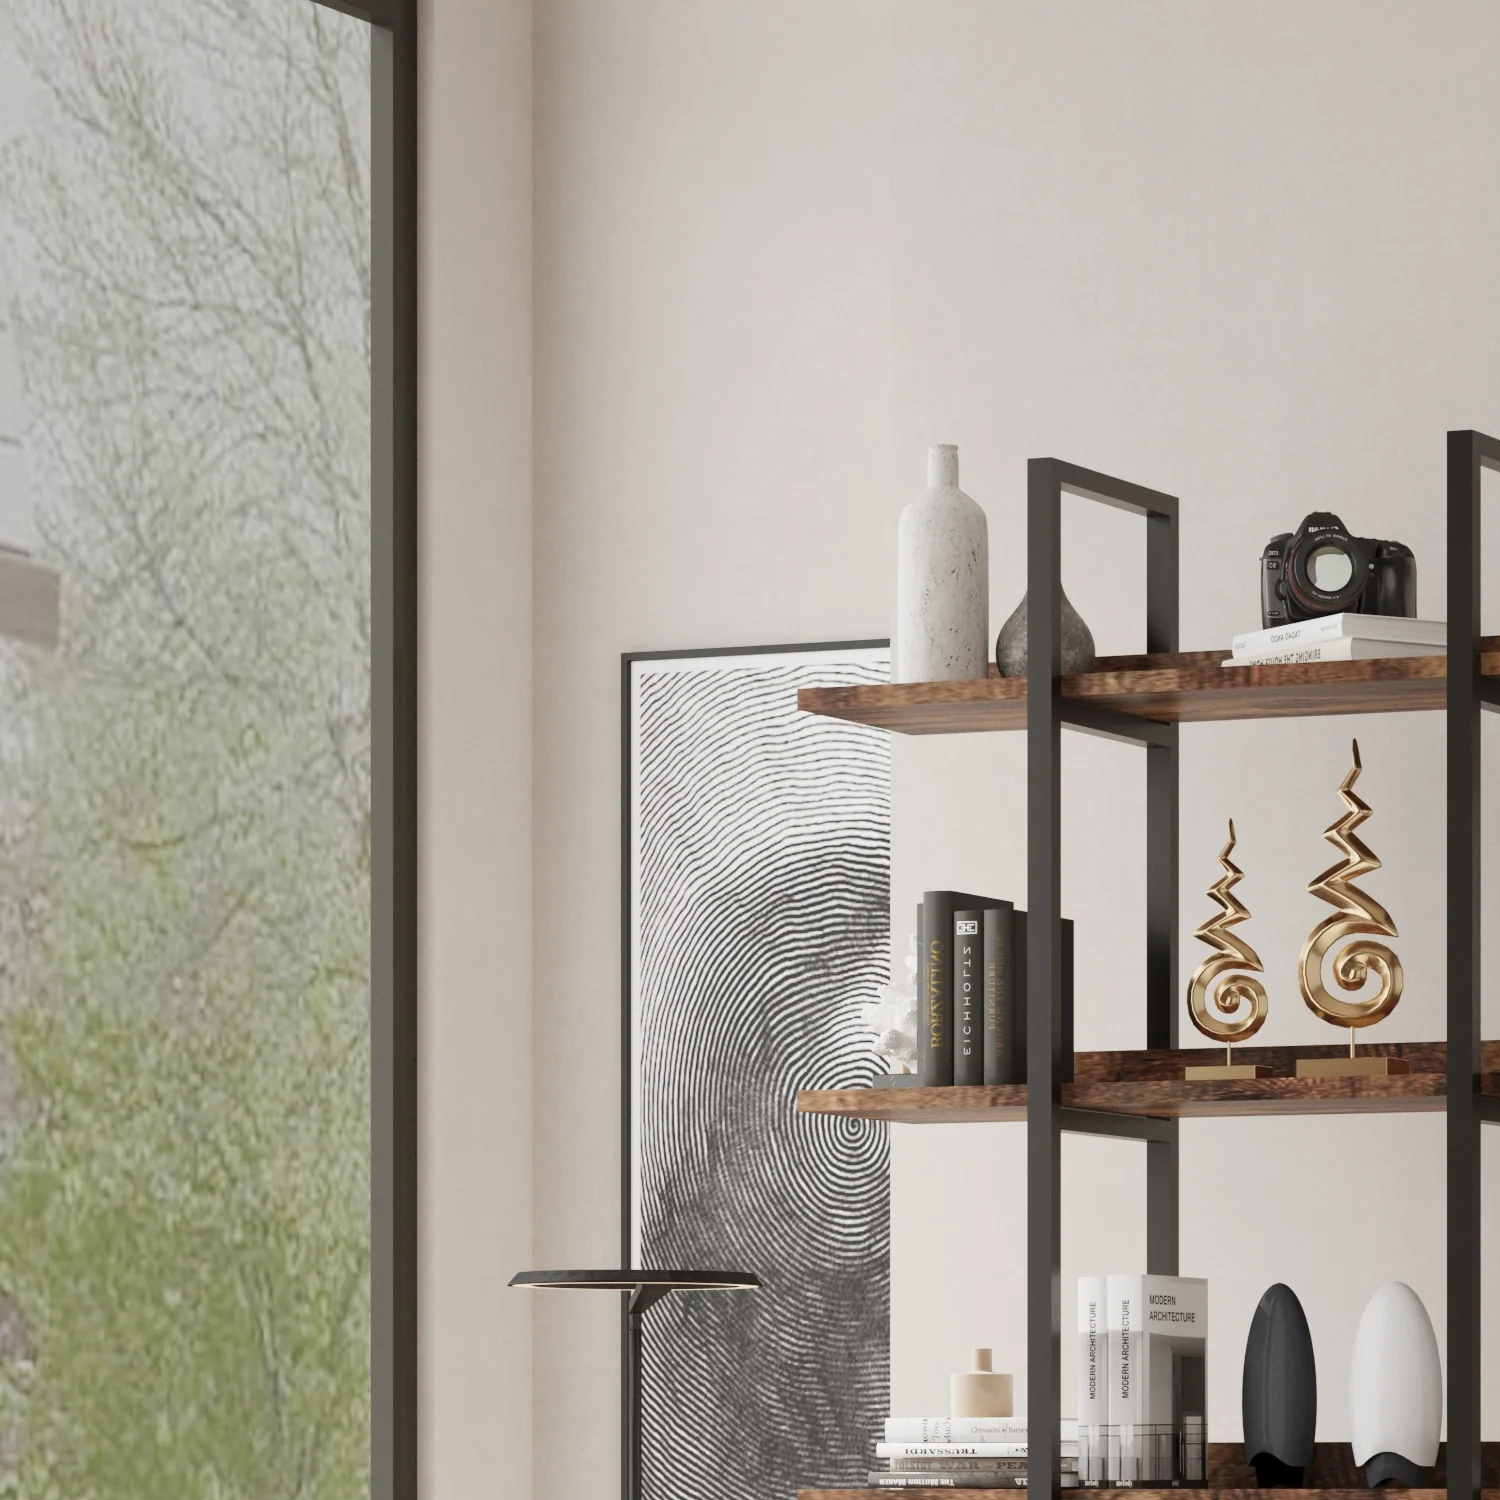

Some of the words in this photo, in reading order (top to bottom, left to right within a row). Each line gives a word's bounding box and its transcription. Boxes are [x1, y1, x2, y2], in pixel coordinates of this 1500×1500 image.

[1149, 1295, 1176, 1306] MODERN
[1149, 1312, 1196, 1323] ARCHITECTURE
[1089, 1302, 1097, 1363] ARCHITECTURE
[1121, 1300, 1130, 1362] ARCHITECTURE
[1121, 1364, 1130, 1399] MODERN
[894, 1460, 932, 1470] TOLSTOY
[940, 1461, 980, 1470] WAR
[996, 1462, 1028, 1470] PEA
